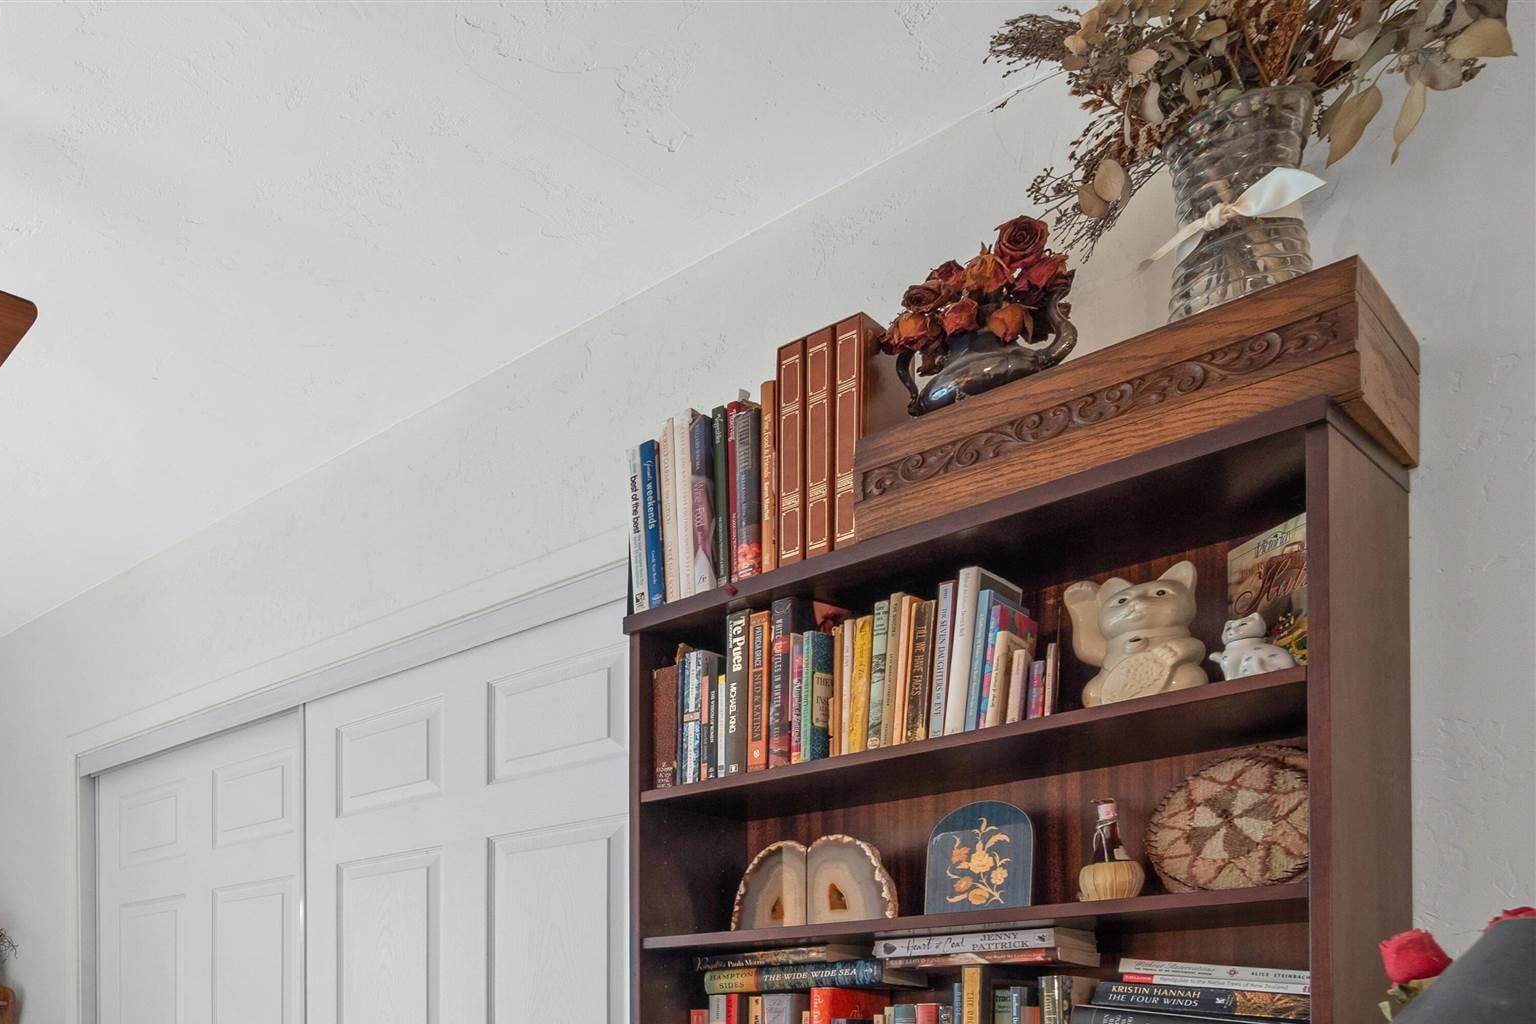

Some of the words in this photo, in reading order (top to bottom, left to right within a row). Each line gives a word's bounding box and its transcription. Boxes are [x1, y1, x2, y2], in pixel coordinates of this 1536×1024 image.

[630, 476, 638, 492] best
[631, 494, 638, 502] of
[646, 482, 656, 529] weekends
[633, 517, 641, 534] best
[733, 617, 745, 634] Te
[916, 625, 927, 639] TILL
[939, 620, 947, 645] SEVEN
[754, 627, 763, 649] PATRICIA
[915, 642, 925, 652] WE
[754, 650, 763, 667] GRACE
[913, 655, 924, 672] HAVE
[936, 647, 945, 691] DAUGHTERS
[754, 673, 762, 693] NED
[729, 683, 737, 714] MICHAEL
[729, 716, 737, 733] KING
[754, 704, 762, 738] KATINA
[980, 932, 1019, 941] JENNY
[972, 940, 1029, 951] PATTRICK
[709, 971, 753, 980] HAMPTON
[784, 972, 808, 980] WIDE
[811, 970, 836, 978] WIDE
[839, 968, 857, 976] SEA
[1112, 985, 1151, 995] KRISTIN
[1154, 987, 1201, 998] HANNAH
[1044, 990, 1056, 1011] Tom
[1108, 994, 1127, 1002] THE
[1130, 995, 1159, 1004] FOUR
[1163, 997, 1199, 1007] WINDS
